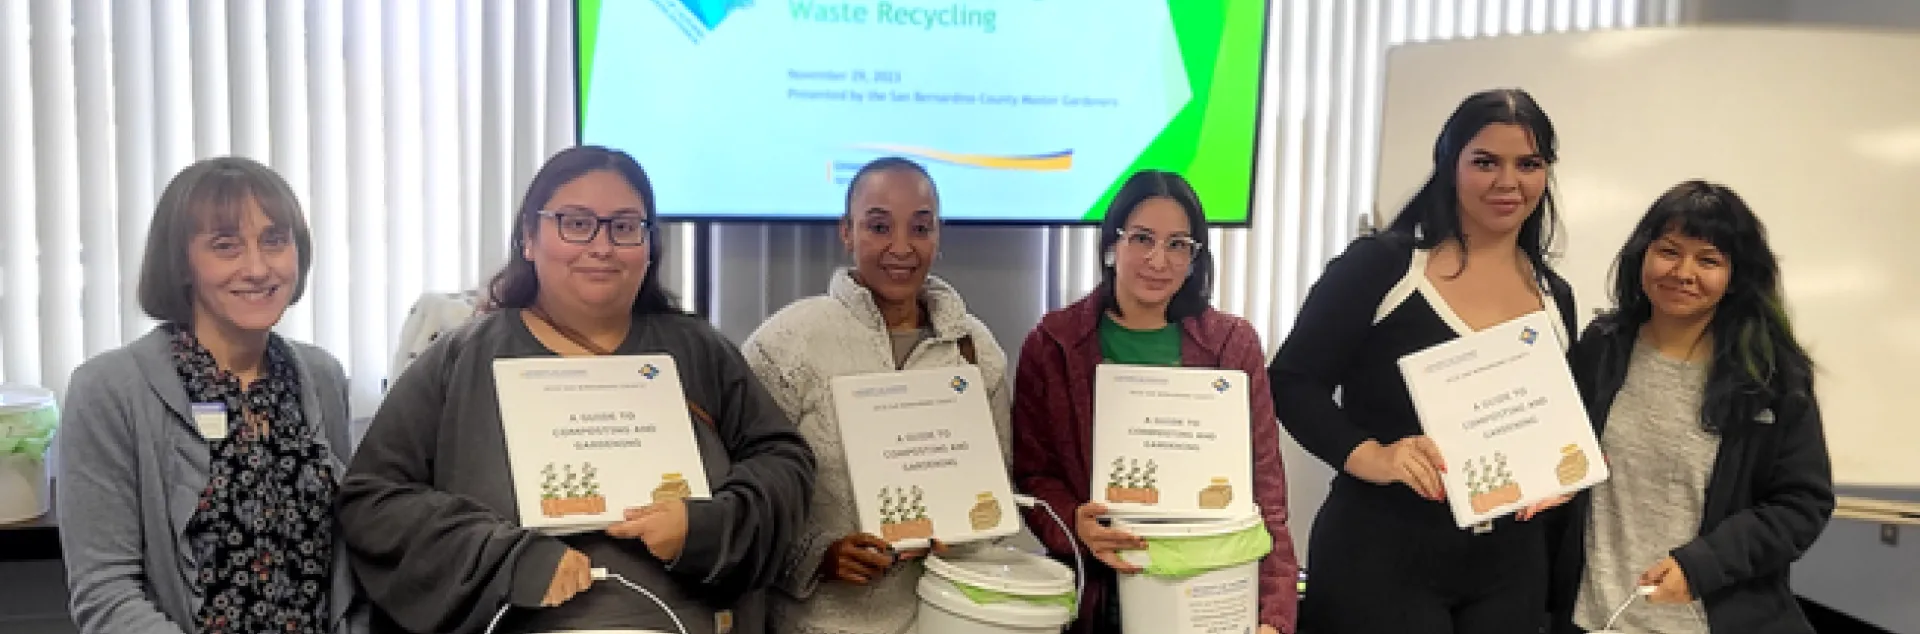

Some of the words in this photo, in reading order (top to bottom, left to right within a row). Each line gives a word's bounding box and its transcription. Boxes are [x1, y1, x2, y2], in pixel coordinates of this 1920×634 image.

[787, 0, 869, 24] Waste
[876, 1, 998, 33] Recycling
[787, 69, 847, 81] November
[787, 88, 847, 101] Presented
[850, 88, 864, 104] by
[867, 89, 887, 102] the
[890, 90, 911, 103] San
[914, 90, 976, 104] Bernardino
[979, 92, 1018, 108] County
[1061, 94, 1119, 108] Gardeners
[580, 411, 616, 422] GUIDE
[620, 410, 636, 421] TO
[552, 425, 630, 438] COMPOSTING
[634, 424, 657, 434] AND
[906, 431, 934, 442] GUIDE
[573, 437, 642, 450] GARDENING
[883, 444, 948, 460] COMPOSTING
